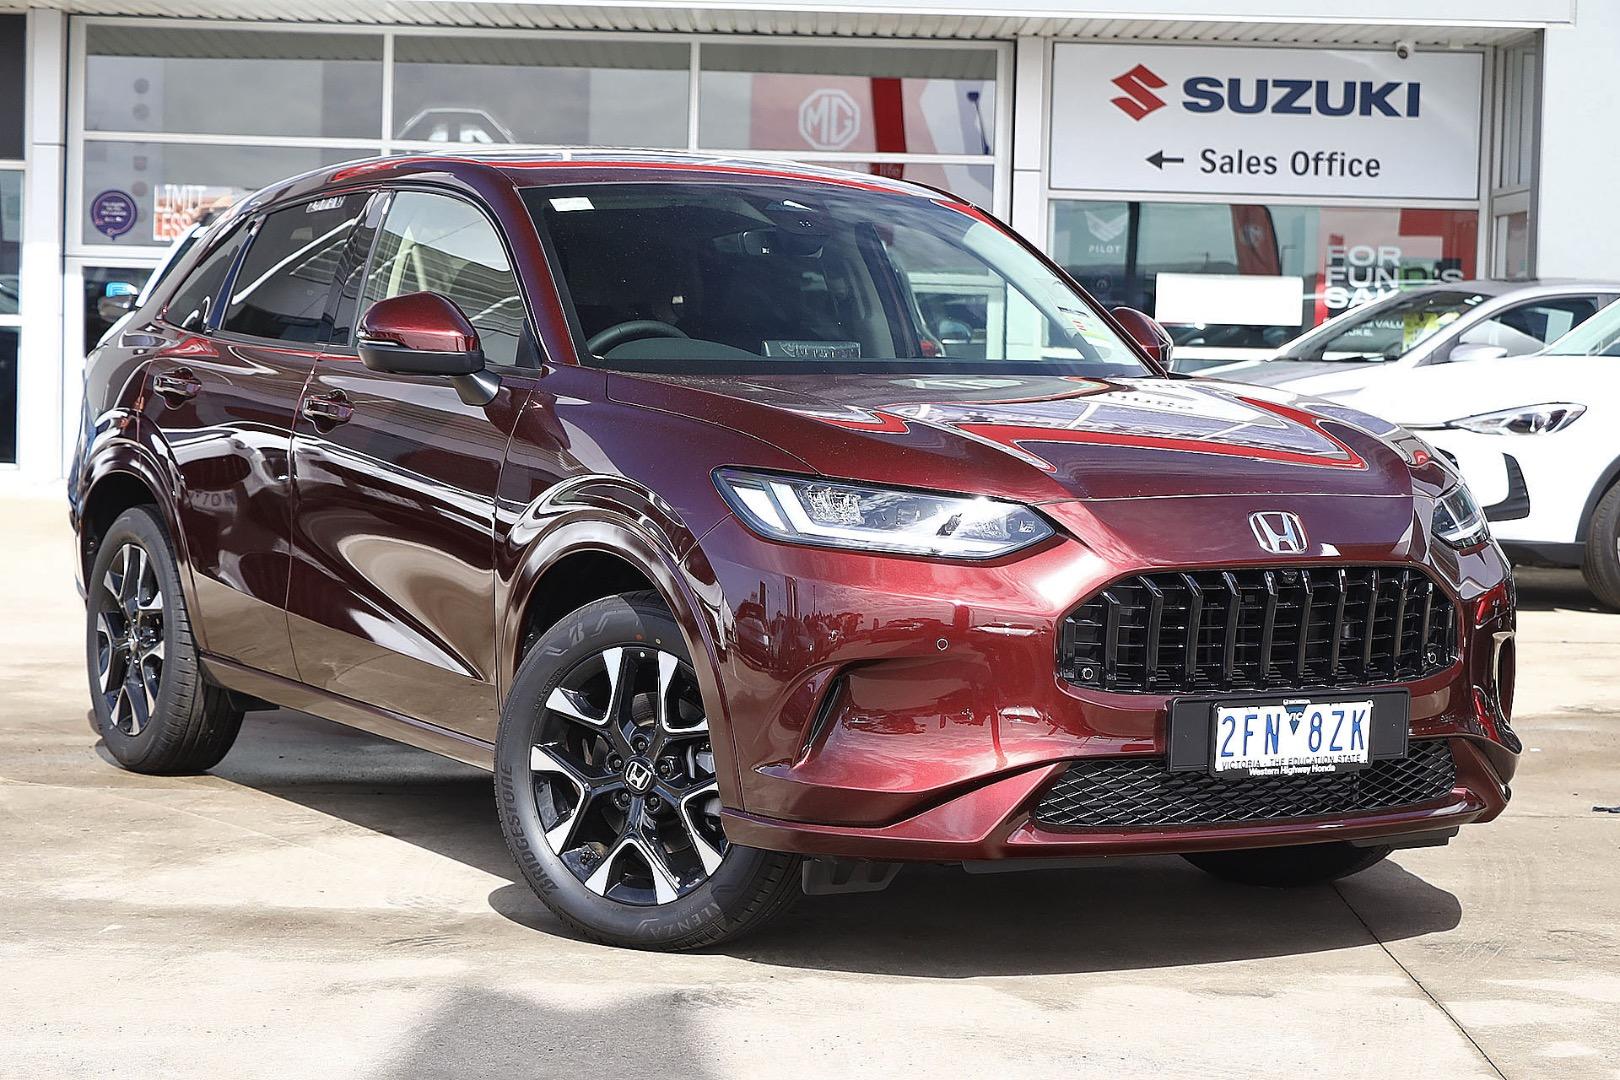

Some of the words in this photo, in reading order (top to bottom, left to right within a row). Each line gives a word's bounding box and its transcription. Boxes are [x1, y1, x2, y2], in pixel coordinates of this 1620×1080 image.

[1182, 77, 1420, 117] SUZUKI
[802, 93, 856, 146] MG
[1200, 149, 1277, 174] Sales
[1290, 151, 1381, 177] Office
[1088, 244, 1122, 254] PILOT
[1327, 244, 1402, 267] FOR
[1221, 713, 1281, 758] 2FN
[1308, 709, 1366, 753] 8ZK
[1222, 760, 1260, 770] VICTORIA
[1288, 756, 1335, 766] EDUCATION
[1338, 753, 1361, 763] STATE
[1248, 767, 1280, 776] Western
[1280, 764, 1311, 775] Highway
[1311, 763, 1336, 773] Honda
[500, 762, 560, 896] BRIDGESTONE
